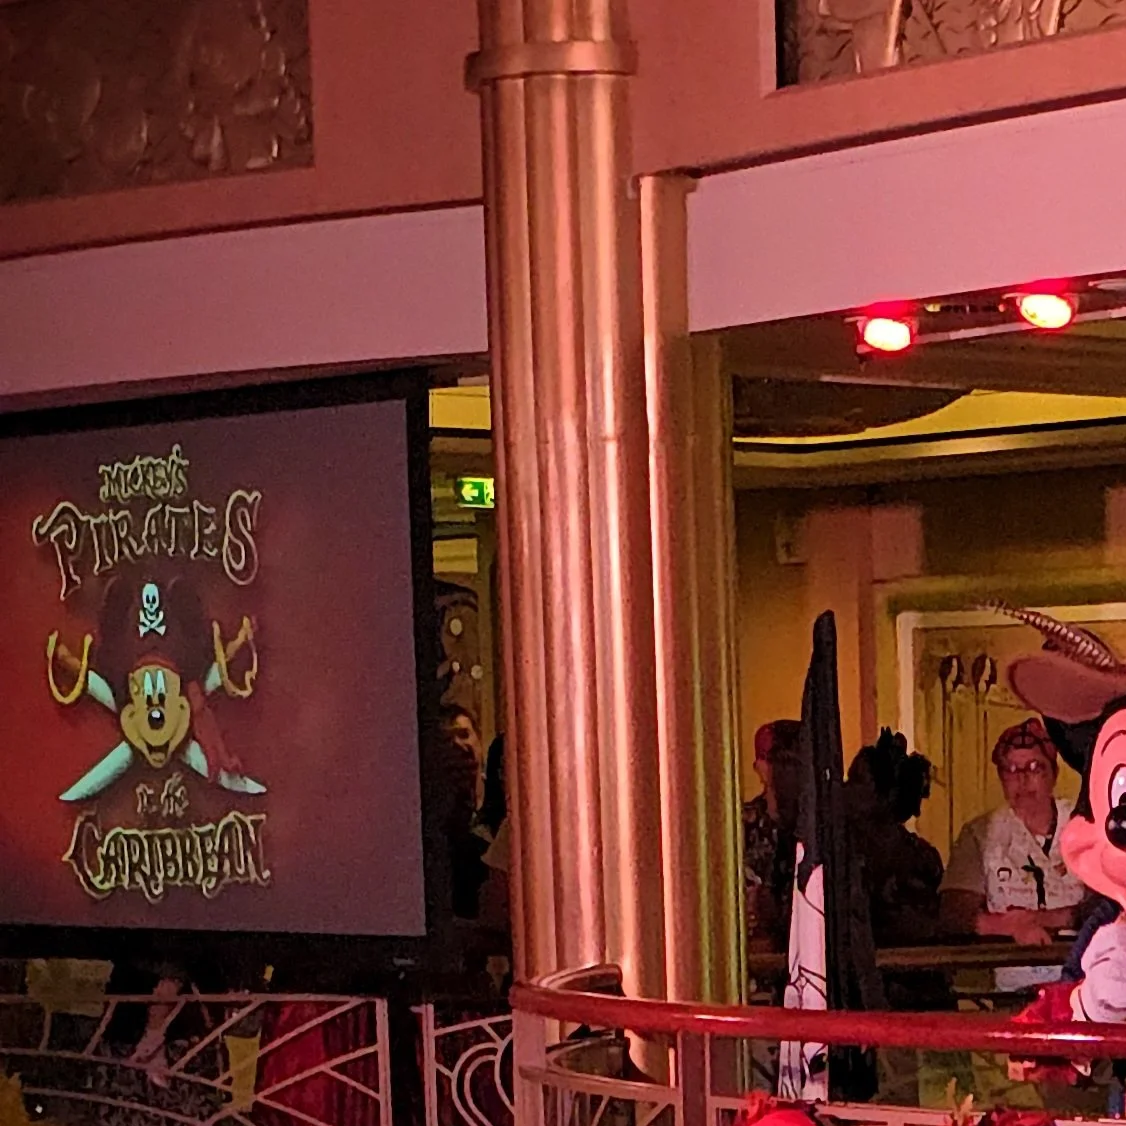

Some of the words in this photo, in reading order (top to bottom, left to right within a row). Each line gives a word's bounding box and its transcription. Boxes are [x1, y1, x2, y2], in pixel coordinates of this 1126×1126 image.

[99, 443, 189, 504] MICKEY'S
[32, 490, 262, 601] PIRATES
[61, 808, 271, 904] CARIBBEAN
